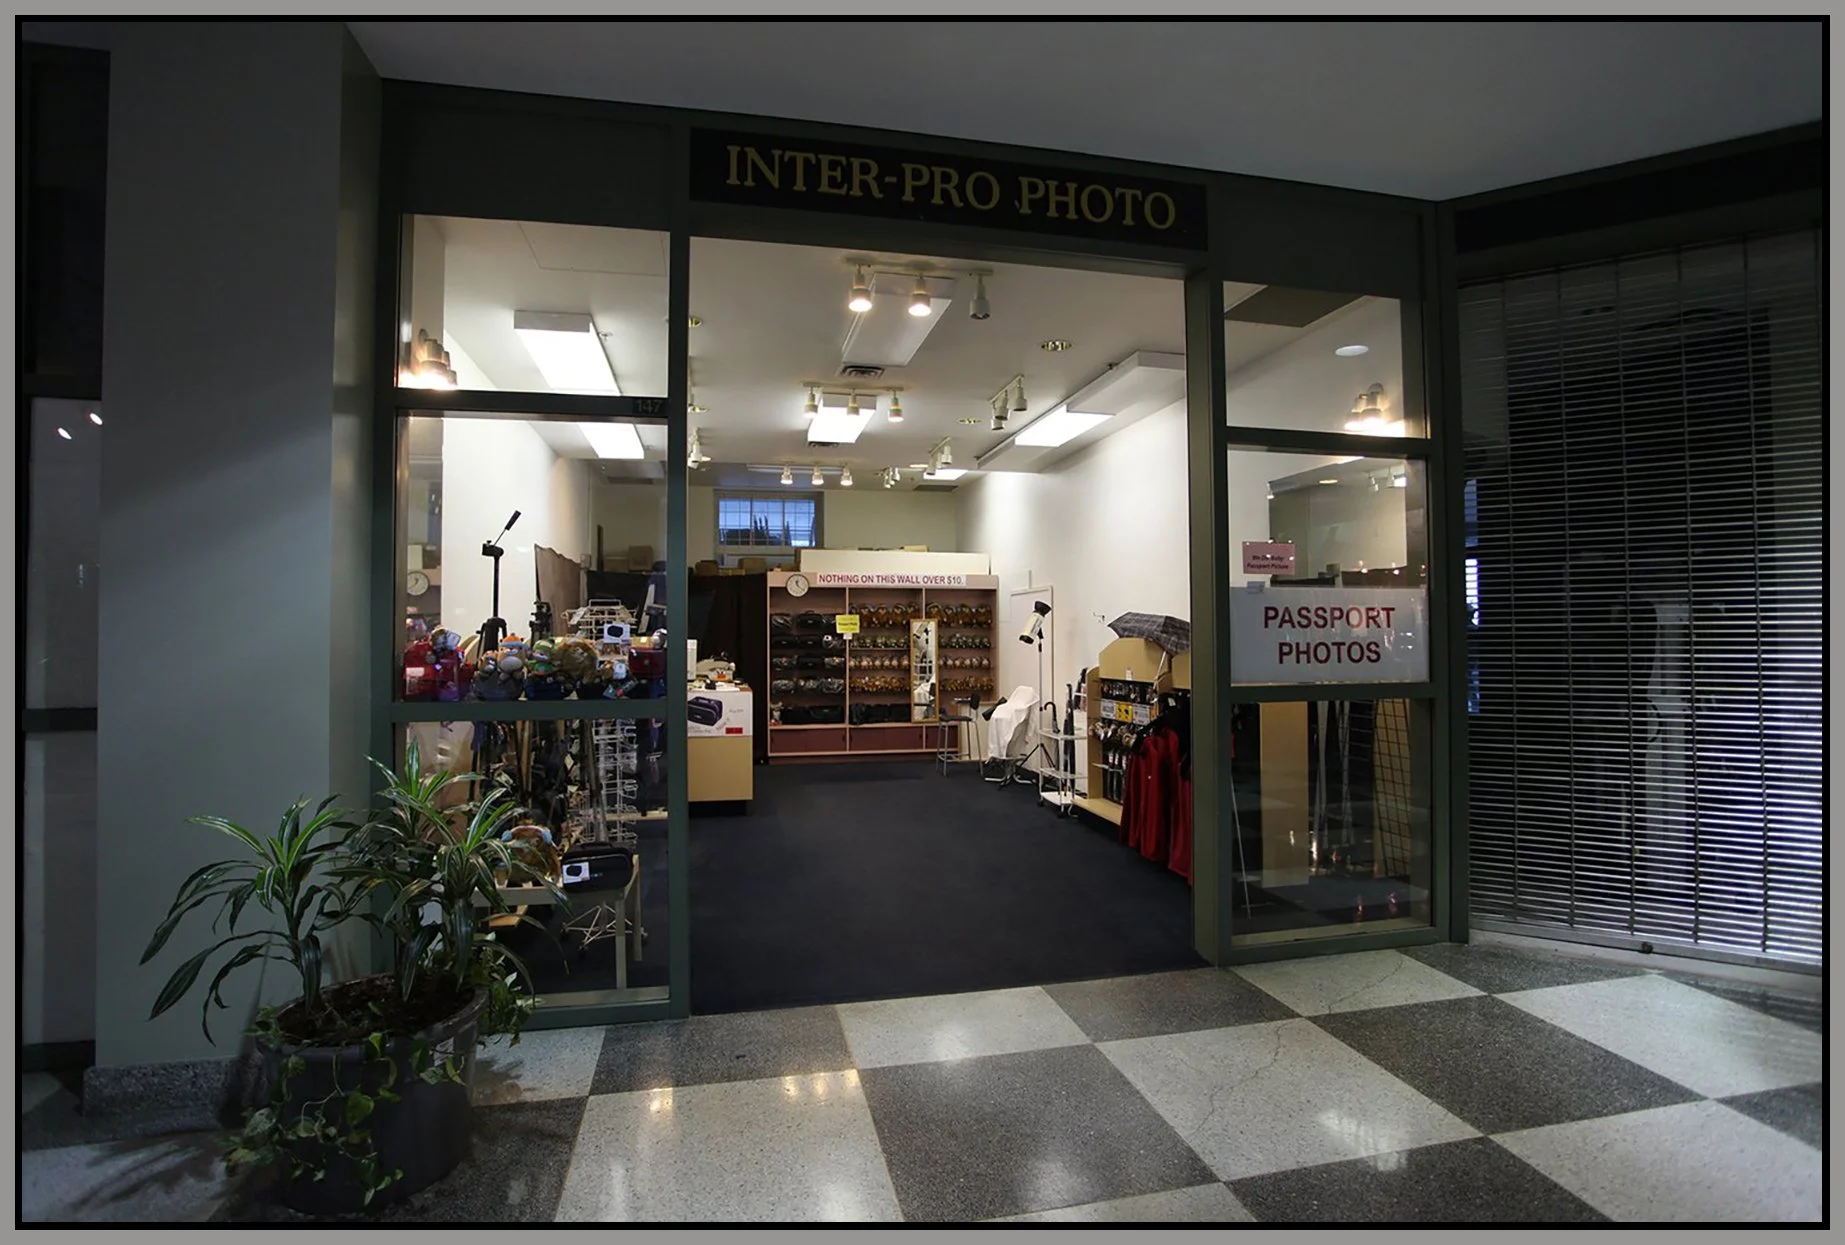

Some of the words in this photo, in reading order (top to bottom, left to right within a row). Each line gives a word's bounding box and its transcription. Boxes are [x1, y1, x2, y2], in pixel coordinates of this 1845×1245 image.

[726, 145, 1000, 210] INTER-PRO
[1018, 176, 1176, 230] PHOTO
[635, 399, 663, 413] 147
[819, 574, 860, 584] NOTHING
[861, 574, 874, 584] ON
[876, 574, 896, 585] THIS
[897, 575, 920, 585] WALL
[922, 575, 946, 585] OVER
[1264, 606, 1395, 629] PASSPORT
[1278, 641, 1381, 664] PHOTOS
